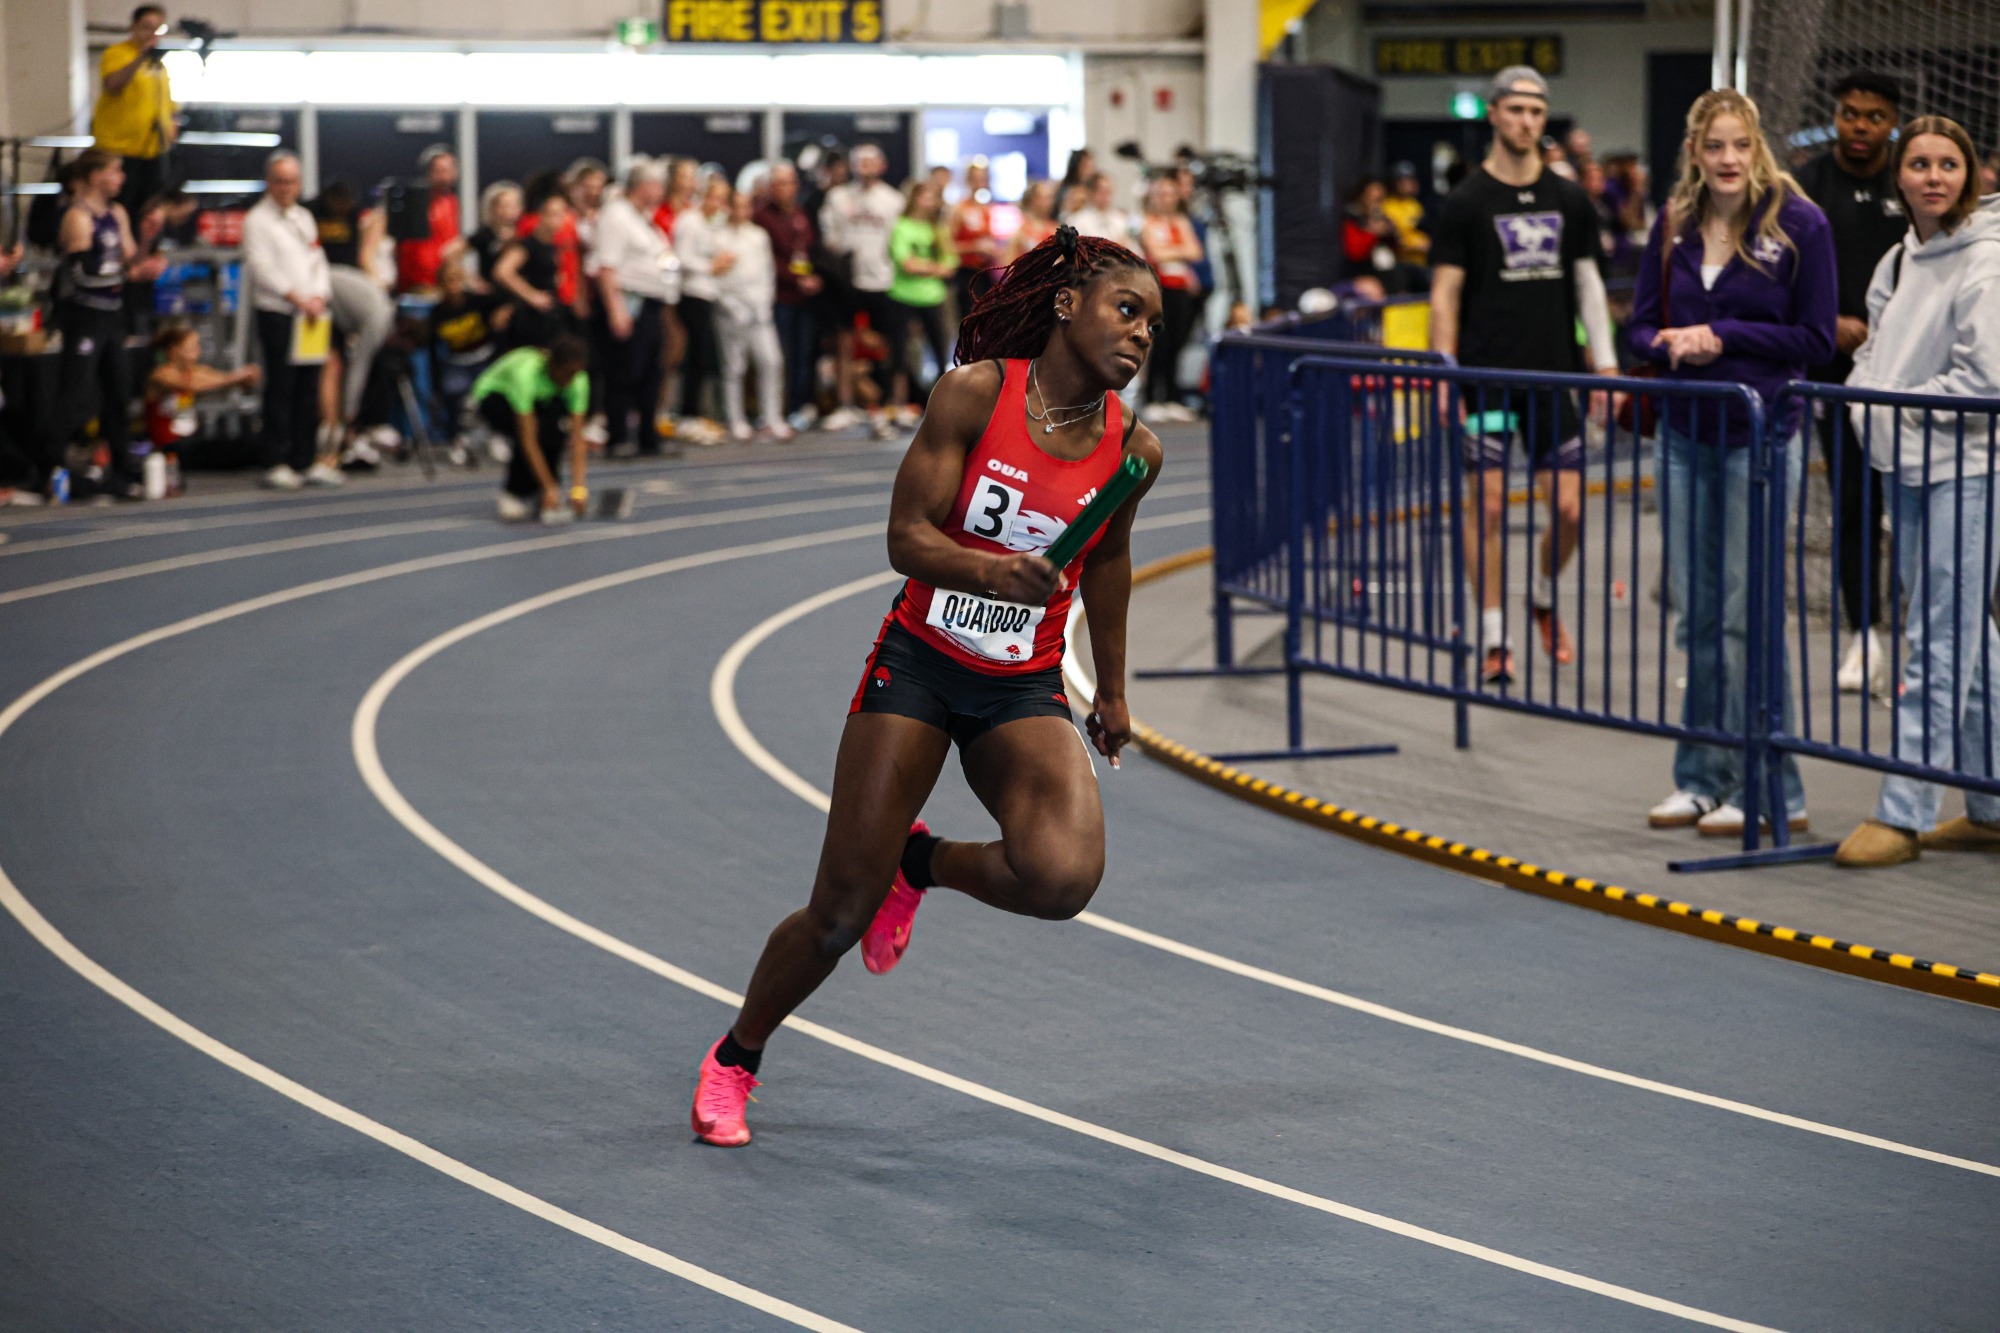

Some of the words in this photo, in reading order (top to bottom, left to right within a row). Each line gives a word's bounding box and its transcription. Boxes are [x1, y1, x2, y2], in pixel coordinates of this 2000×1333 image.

[668, 0, 754, 41] FIRE
[759, 0, 845, 41] EXIT
[852, 0, 880, 42] 5
[1376, 39, 1446, 74] FIRE
[1454, 39, 1527, 74] EXIT
[987, 458, 1029, 483] OUA
[973, 484, 1010, 538] 3
[942, 594, 1031, 634] QUAIDOO
